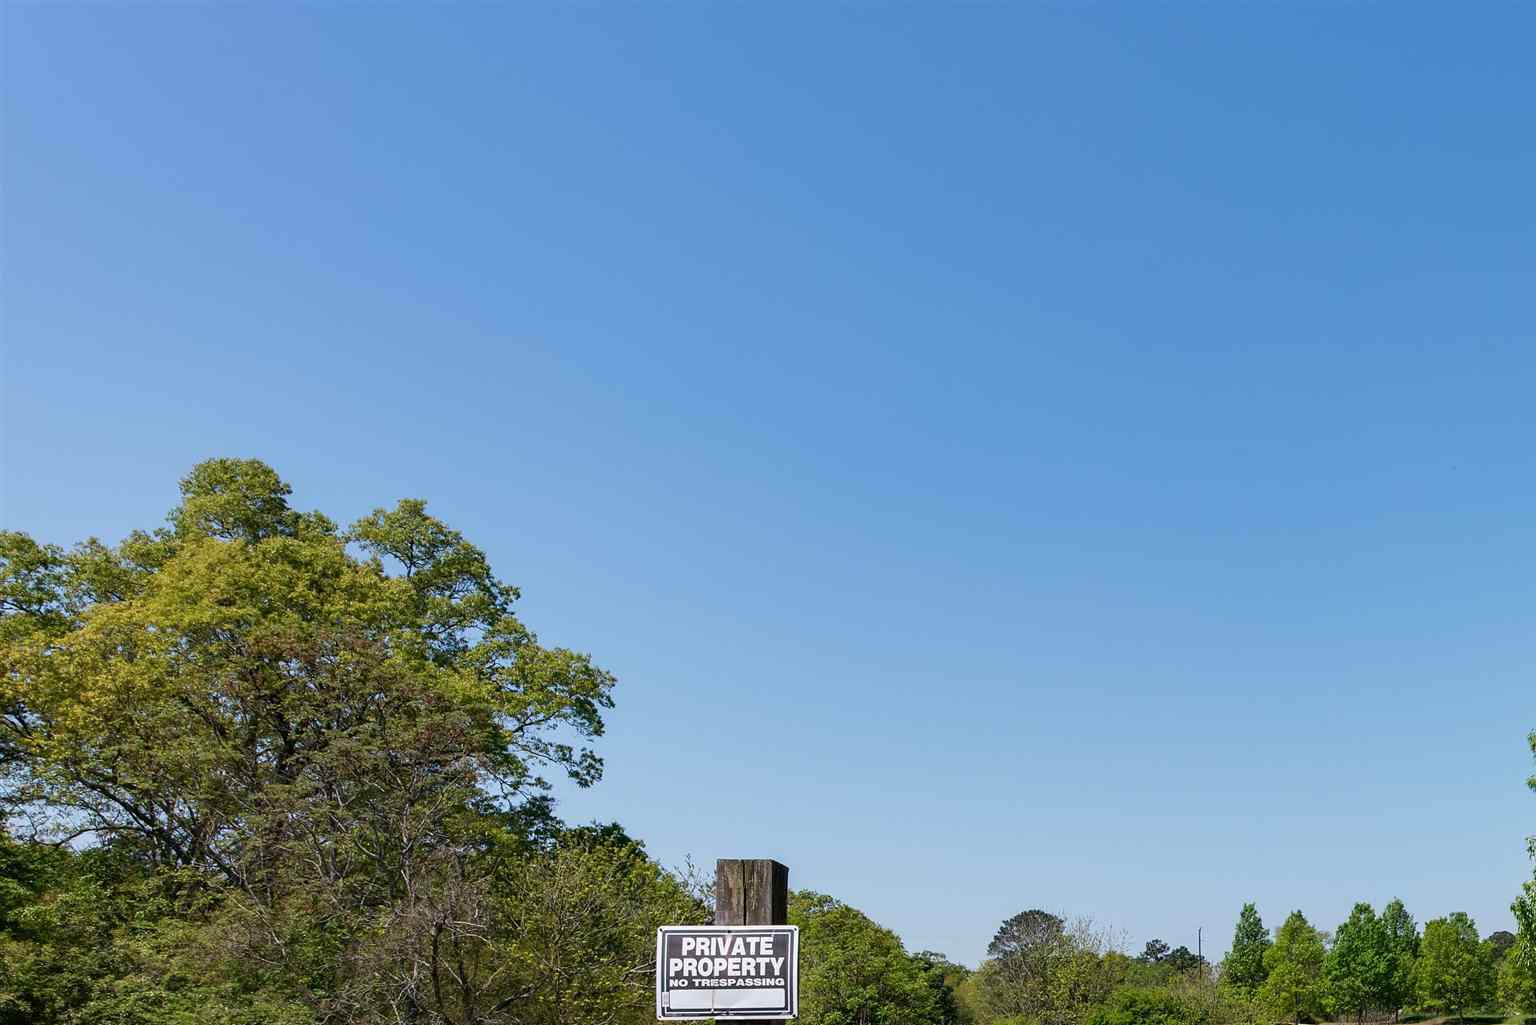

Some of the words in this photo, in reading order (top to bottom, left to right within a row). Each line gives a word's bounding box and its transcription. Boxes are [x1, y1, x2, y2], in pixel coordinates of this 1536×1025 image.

[681, 936, 774, 956] PRIVATE
[669, 957, 785, 977] PROPERTY
[669, 979, 688, 987] NO
[693, 978, 785, 986] TRESPASSING
